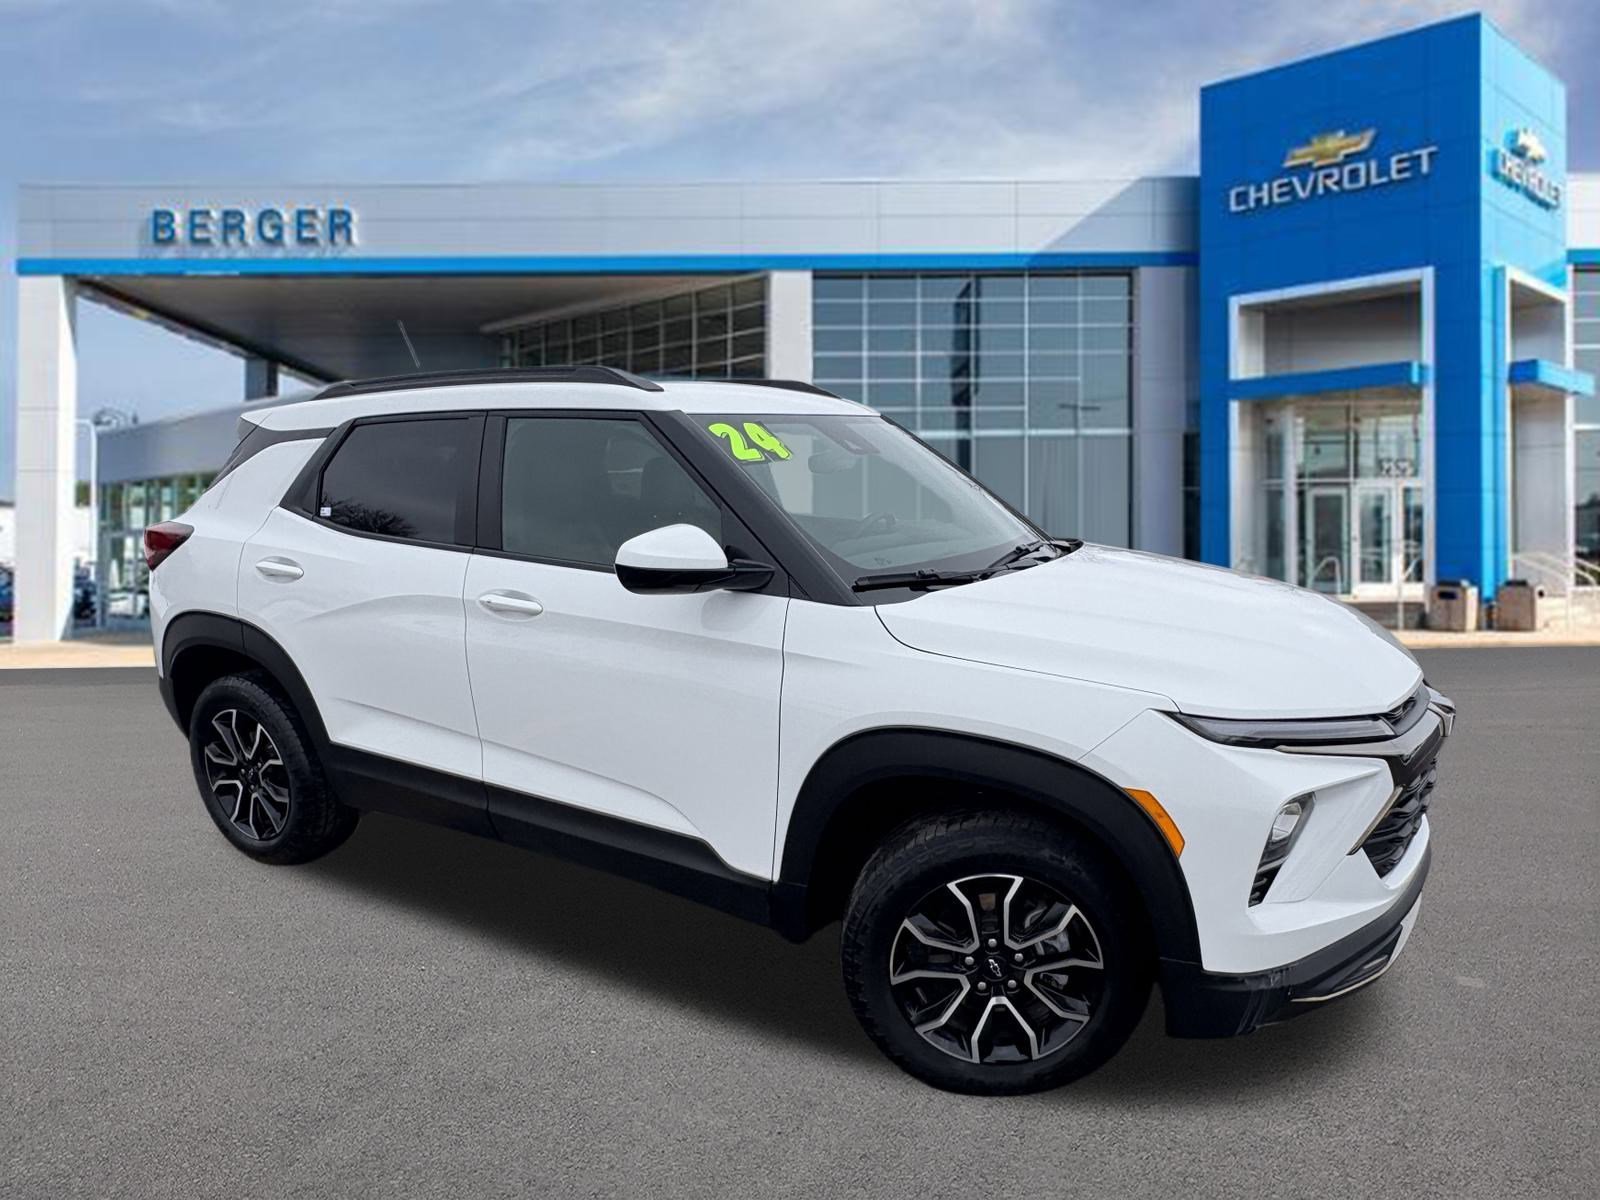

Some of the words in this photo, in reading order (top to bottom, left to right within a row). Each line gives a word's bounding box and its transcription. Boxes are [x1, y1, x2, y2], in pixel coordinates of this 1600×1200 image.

[1229, 146, 1438, 213] CHEVROLET
[151, 208, 357, 246] BERGER
[707, 422, 792, 461] 24
